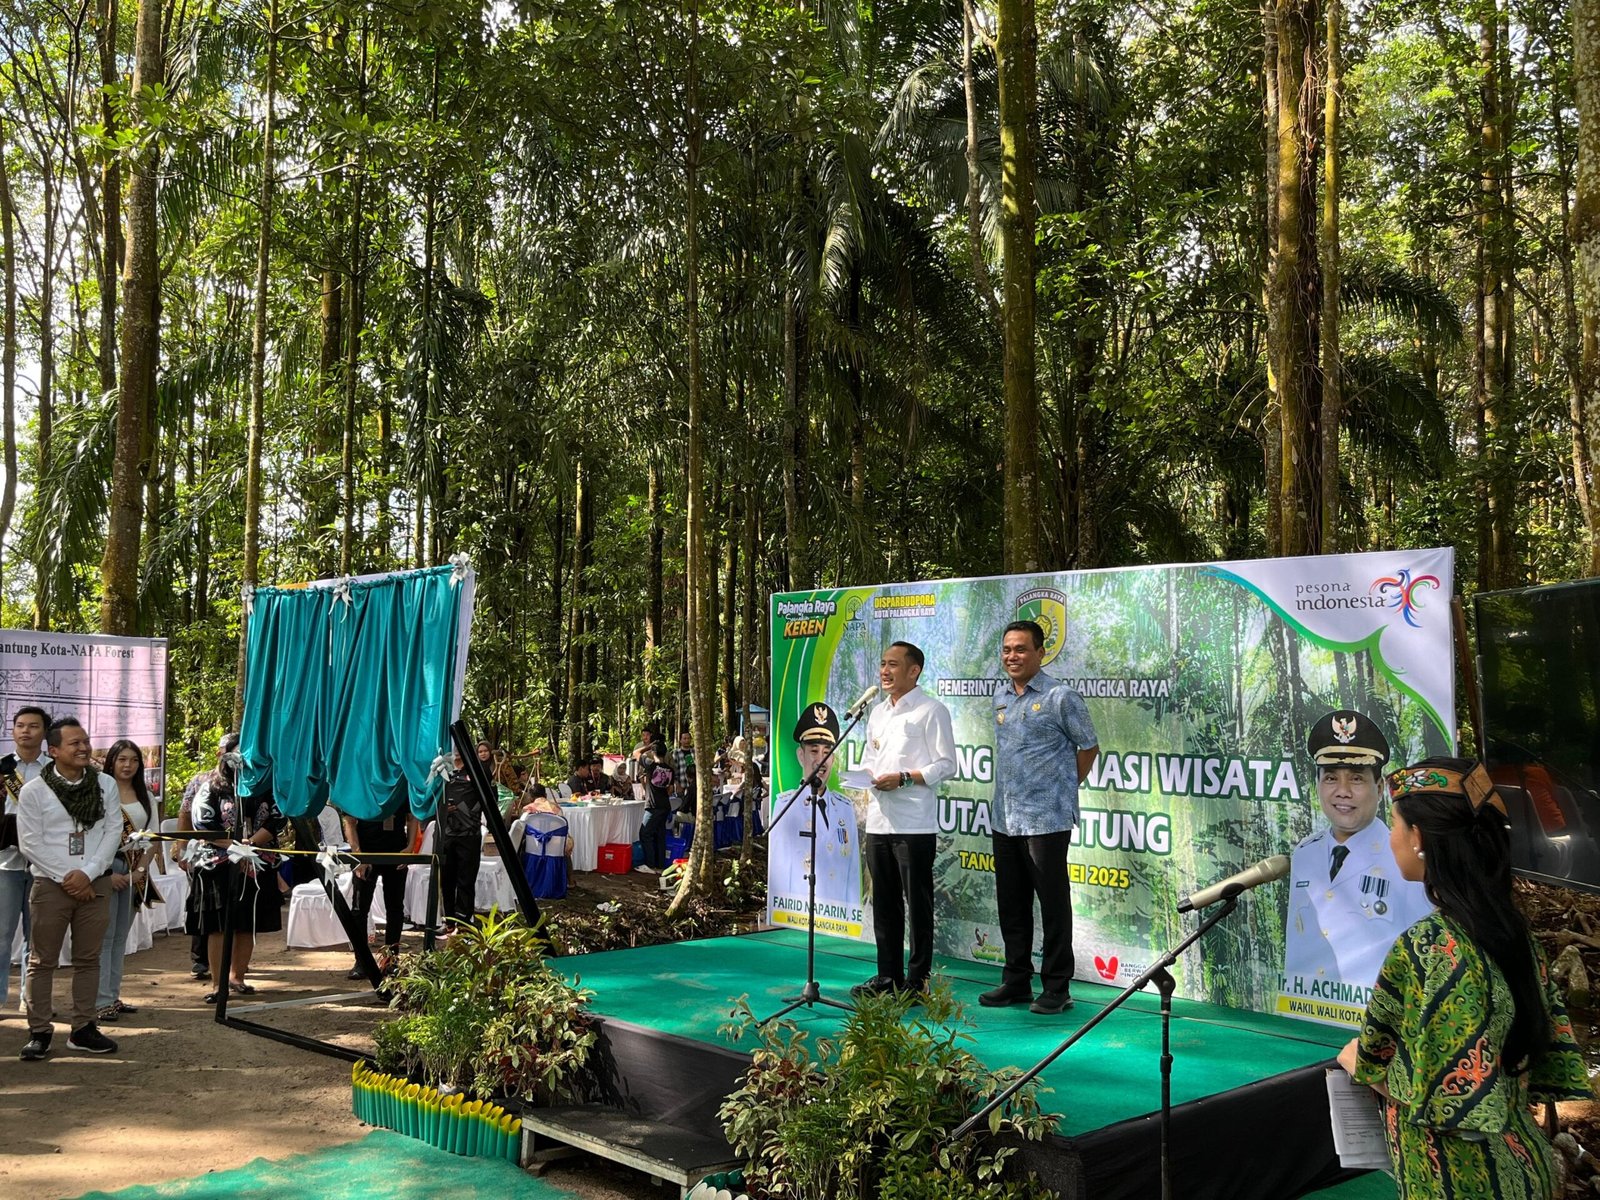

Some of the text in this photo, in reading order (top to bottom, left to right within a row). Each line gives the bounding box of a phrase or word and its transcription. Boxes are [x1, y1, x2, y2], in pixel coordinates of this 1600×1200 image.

[1296, 583, 1351, 597] pesona
[777, 600, 836, 615] Palangka Raya
[874, 594, 935, 608] DISPARBUDPORA
[1296, 595, 1388, 611] indonesia
[890, 608, 919, 618] PALANGKA
[784, 618, 826, 637] KEREN
[843, 622, 866, 631] NAPA
[40, 642, 101, 657] Kota-NAPA
[105, 646, 134, 658] Forest
[1129, 679, 1169, 698] RAYA
[1158, 756, 1300, 799] WISATA
[1067, 864, 1086, 883] EI
[1089, 866, 1129, 888] 2025
[773, 896, 803, 911] FAIRID
[851, 909, 862, 922] SE
[1277, 974, 1290, 992] Ir.
[1293, 976, 1308, 994] H.
[1289, 1000, 1362, 1023] WAKIL WALI KOTA
